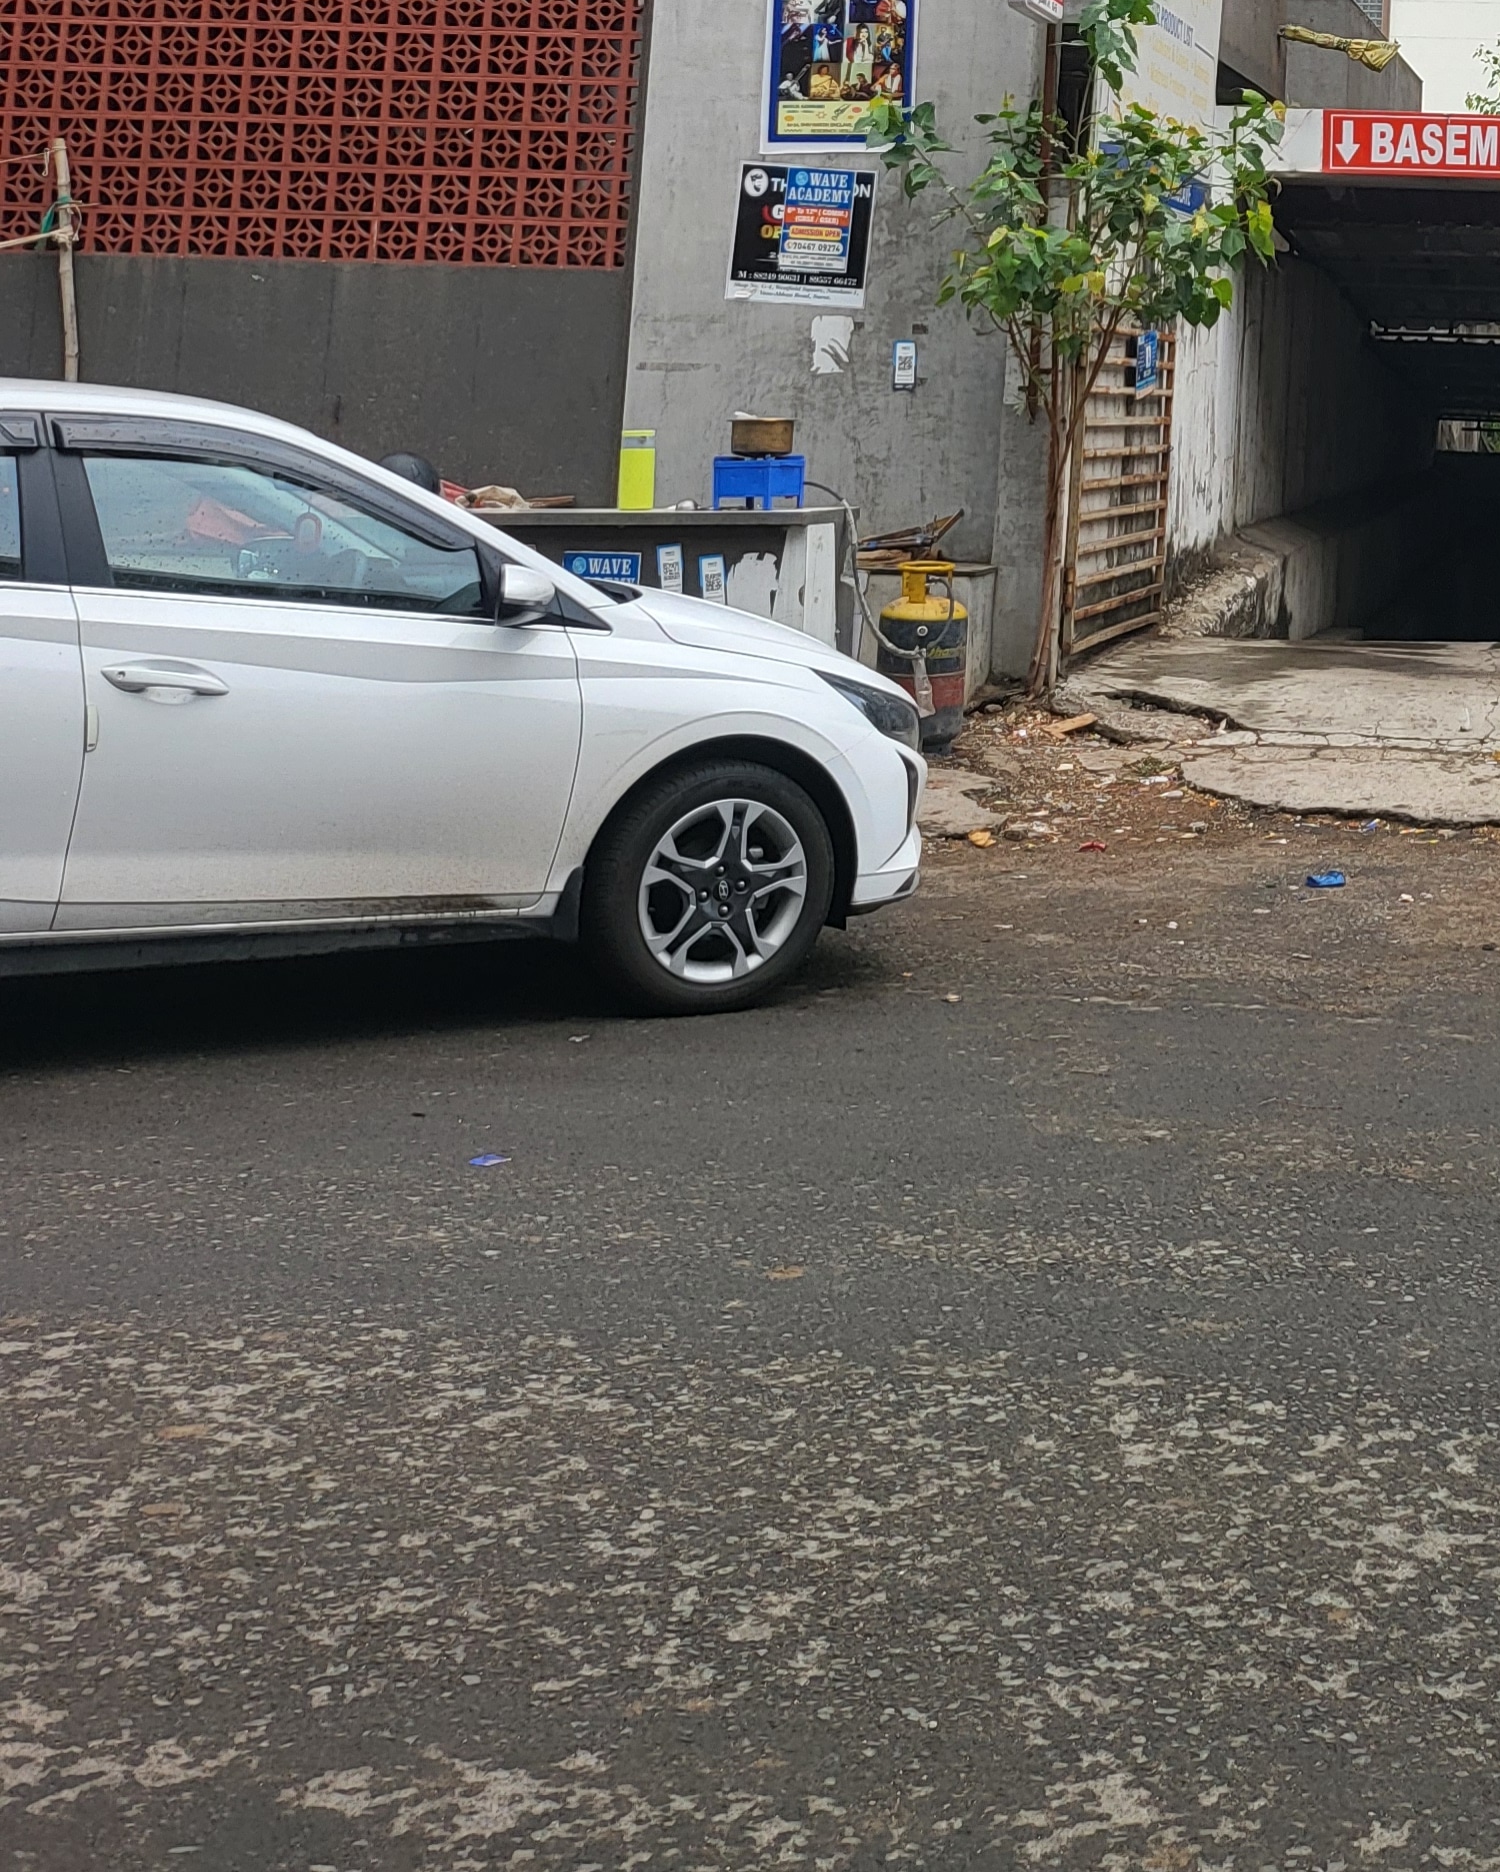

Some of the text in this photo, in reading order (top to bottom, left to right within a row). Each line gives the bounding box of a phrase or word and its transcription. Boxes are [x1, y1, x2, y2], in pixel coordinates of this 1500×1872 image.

[810, 173, 848, 188] WAVE
[788, 187, 851, 204] ACADEMY
[588, 558, 631, 575] WAVE
